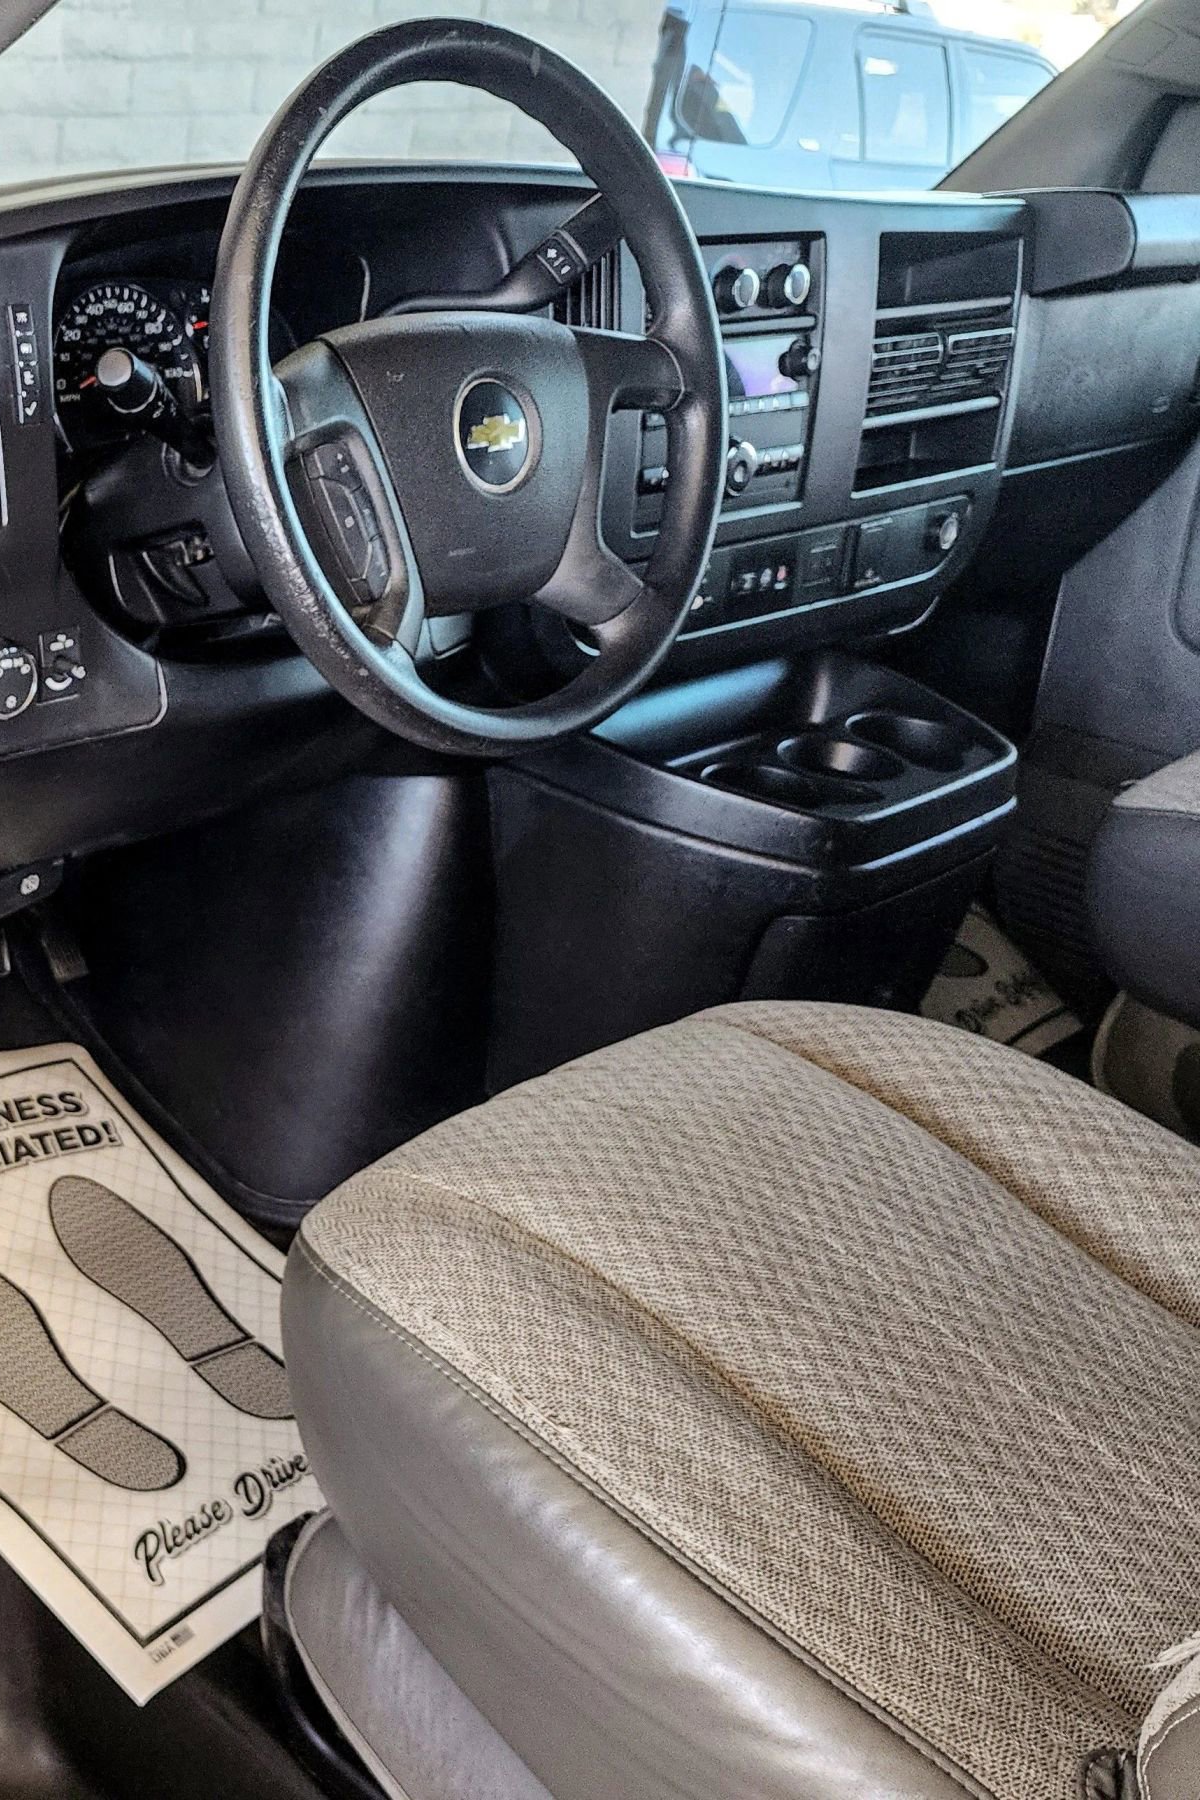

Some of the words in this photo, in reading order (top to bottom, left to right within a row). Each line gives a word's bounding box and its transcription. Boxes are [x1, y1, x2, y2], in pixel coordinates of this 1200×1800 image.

[85, 304, 104, 316] 40
[117, 302, 135, 313] 60
[63, 329, 81, 341] 20
[56, 378, 67, 390] 0
[134, 1499, 227, 1582] Please
[234, 1451, 308, 1518] Drive
